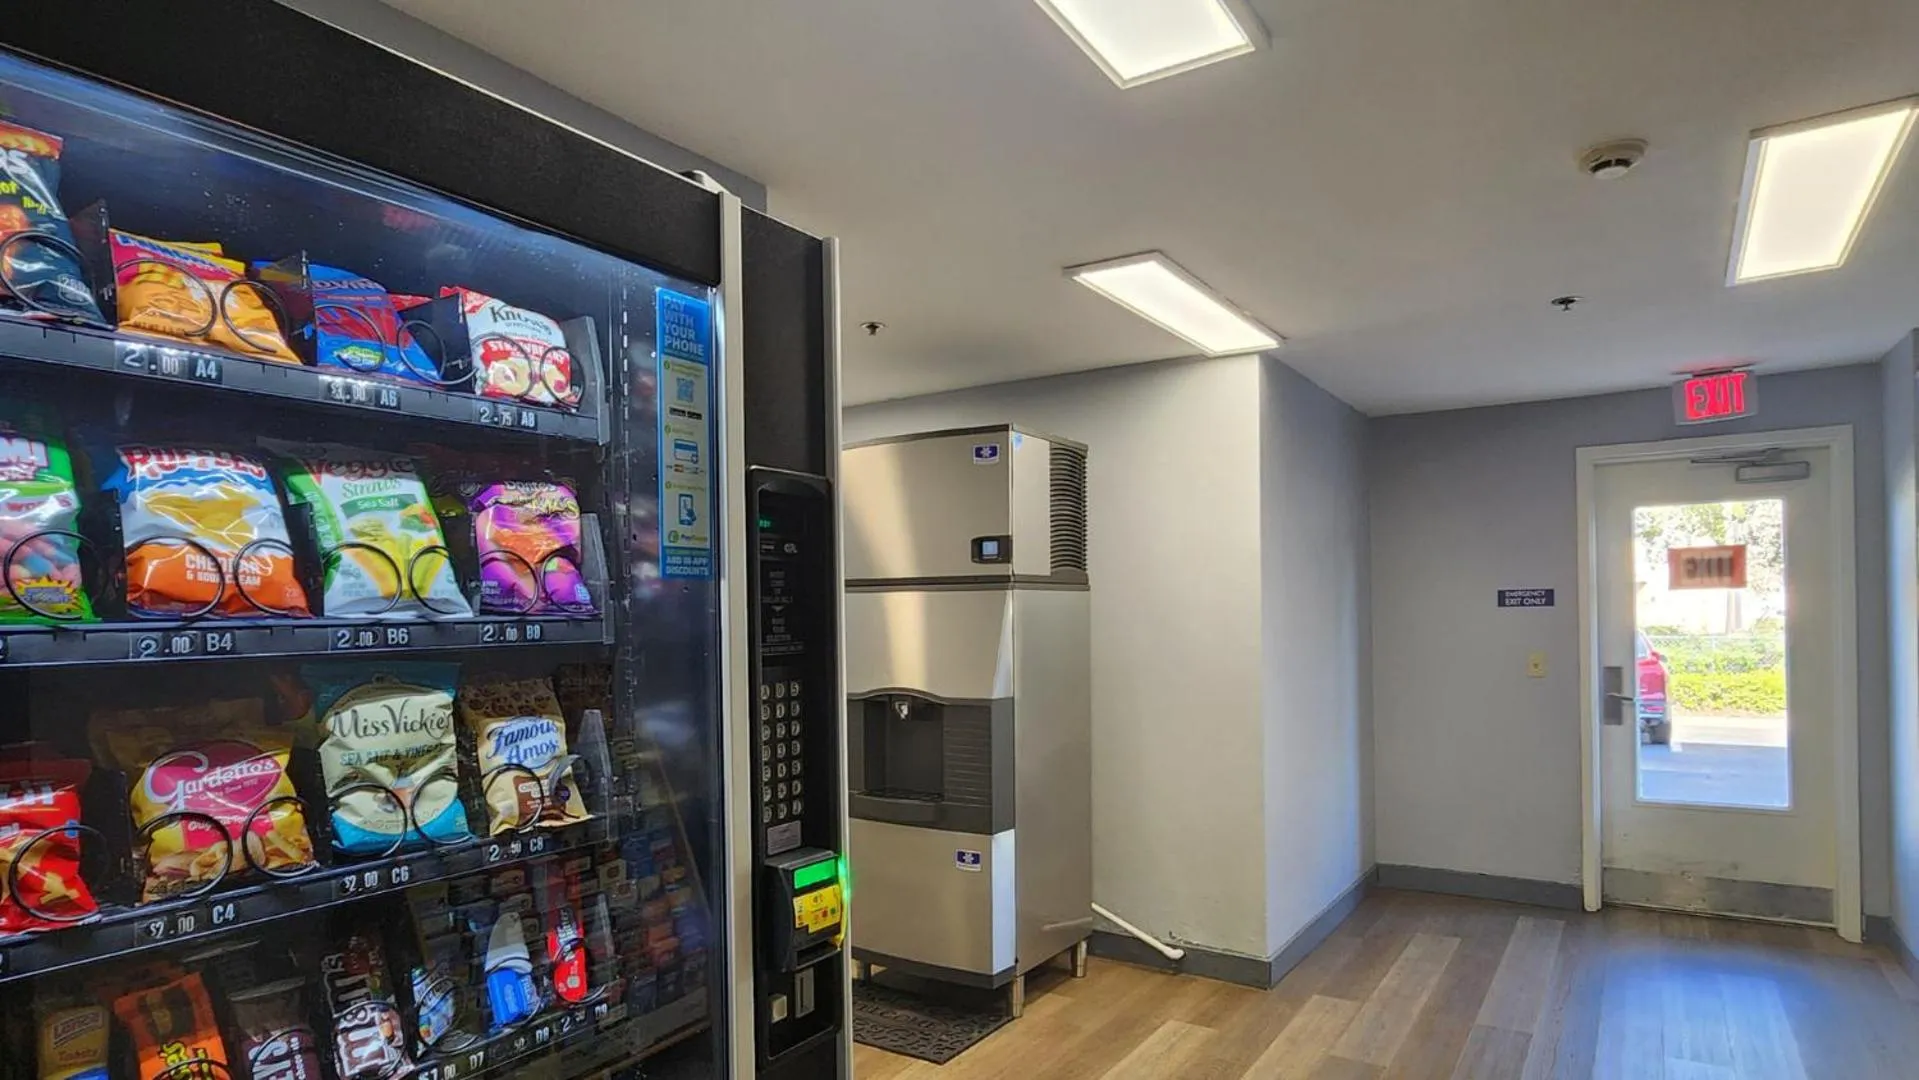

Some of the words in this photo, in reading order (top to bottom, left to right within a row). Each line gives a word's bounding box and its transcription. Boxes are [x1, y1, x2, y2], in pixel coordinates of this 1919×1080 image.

[664, 310, 694, 327] WITH
[664, 322, 696, 340] YOUR
[664, 335, 705, 356] PHONE
[195, 358, 218, 379] A4
[1684, 372, 1748, 420] EXIT
[341, 479, 402, 498] Straws
[1504, 597, 1521, 605] EXIT
[1523, 597, 1546, 605] ONLY
[206, 632, 233, 652] B4
[336, 630, 374, 648] 2.00
[387, 628, 409, 645] B6
[331, 708, 389, 738] Miss
[486, 720, 559, 760] Famous
[340, 750, 363, 766] SEA
[506, 740, 560, 765] Amos
[144, 750, 275, 811] Gardetto's
[150, 917, 195, 939] $2.00
[212, 903, 236, 924] C4
